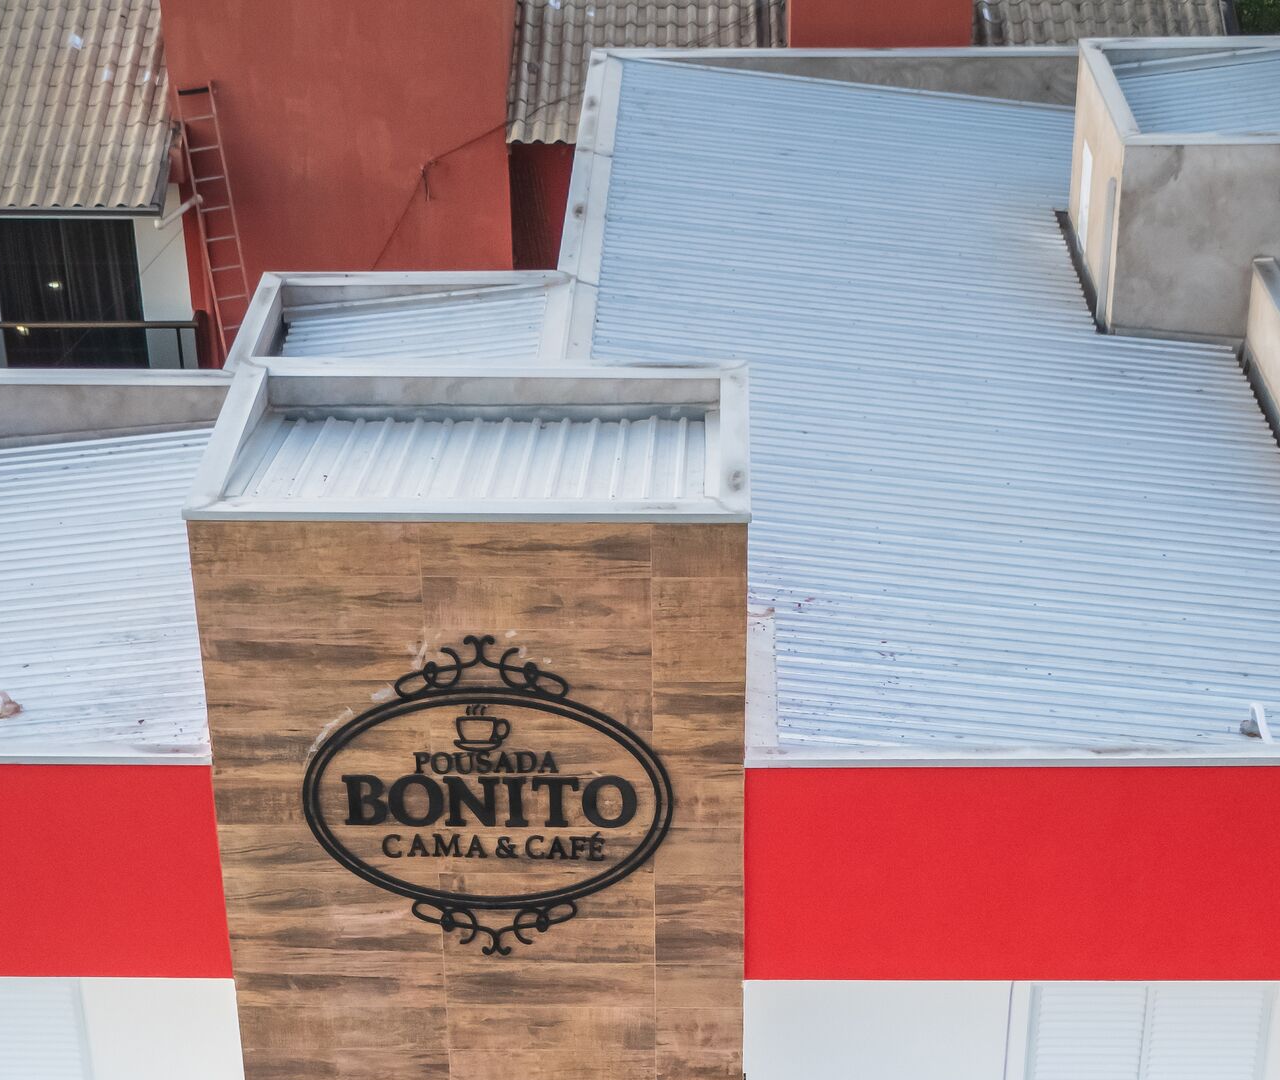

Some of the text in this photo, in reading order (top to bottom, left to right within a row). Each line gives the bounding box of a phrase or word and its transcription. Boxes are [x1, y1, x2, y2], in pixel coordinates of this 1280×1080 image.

[413, 751, 559, 775] POUSADA
[341, 774, 638, 828] BONITO
[381, 831, 606, 862] CAMA & CAFÉ
